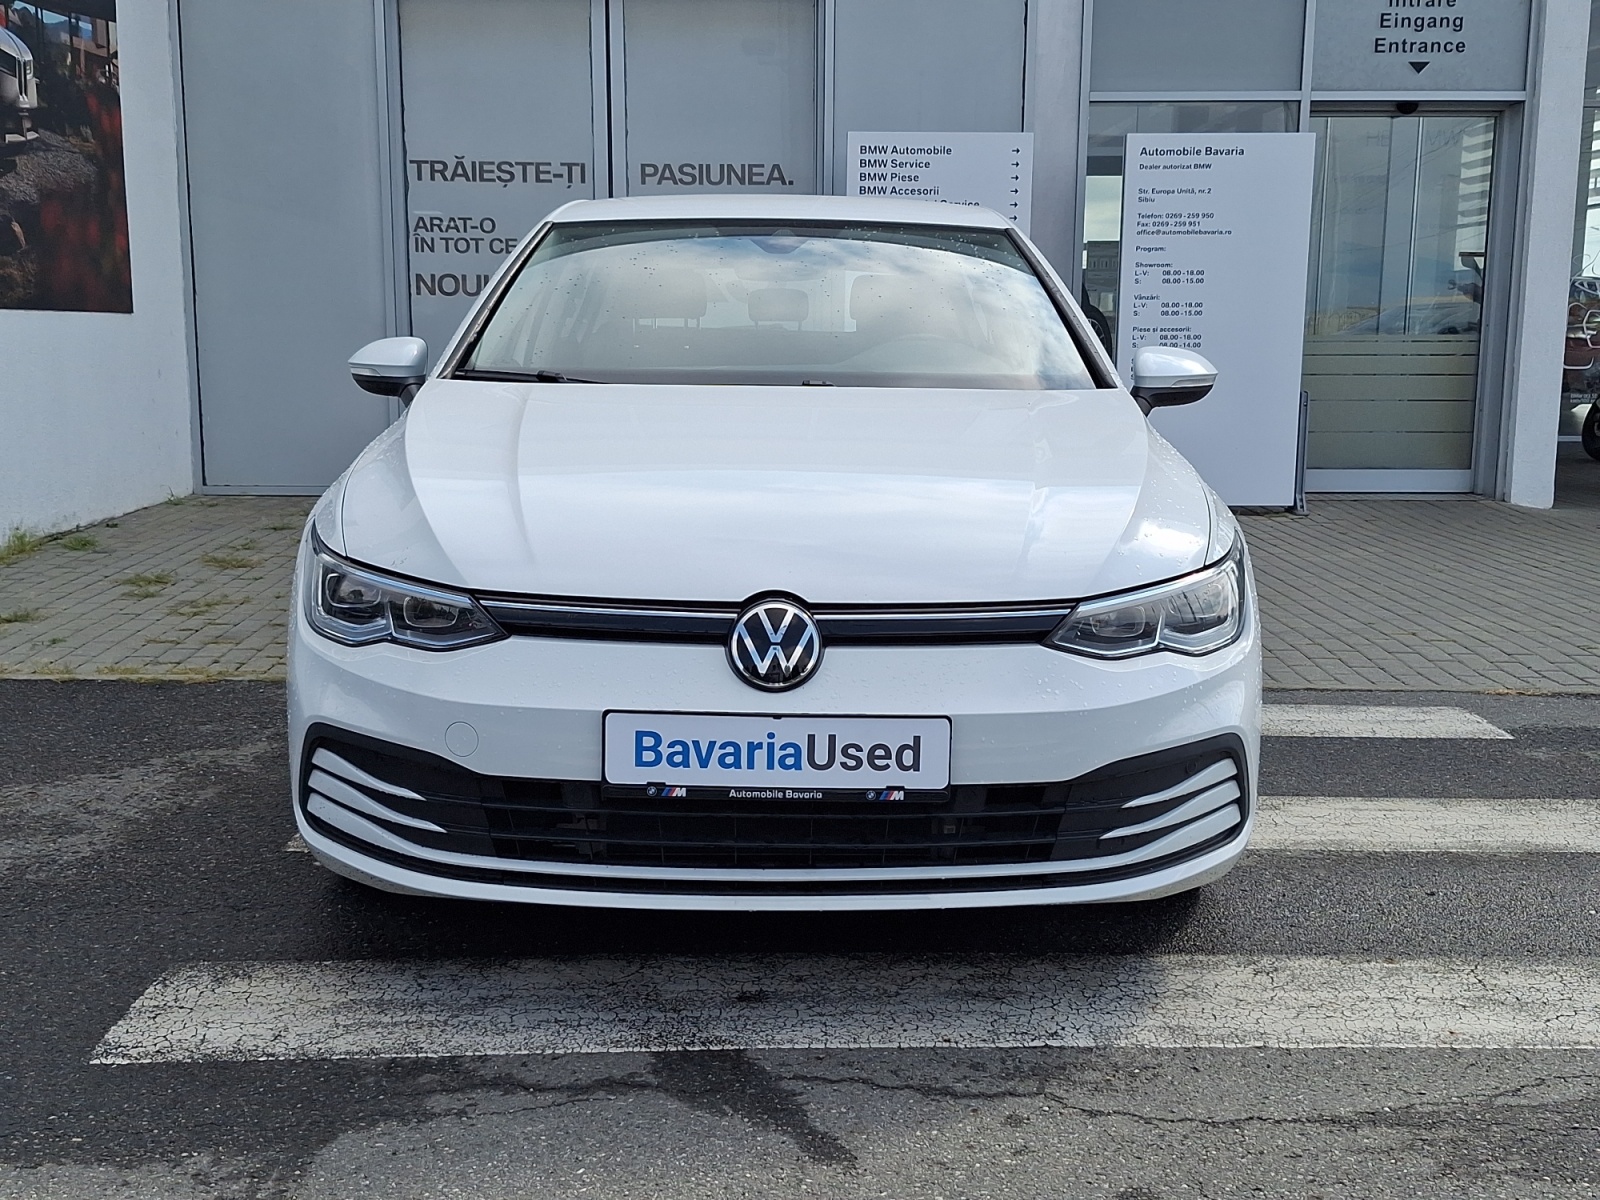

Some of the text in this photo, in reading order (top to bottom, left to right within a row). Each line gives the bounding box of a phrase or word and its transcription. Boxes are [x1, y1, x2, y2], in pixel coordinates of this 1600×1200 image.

[1380, 12, 1464, 32] Eingang
[1374, 38, 1466, 53] Entrance
[859, 145, 952, 155] BMW Automobile
[1140, 146, 1245, 156] Automobile Bavaria
[859, 159, 930, 168] BMW Service
[410, 156, 794, 188] TRĂIEȘTE-ȚI PASIUNEA.
[859, 173, 919, 182] BMW Piese
[859, 186, 939, 195] BMW Accesorii
[413, 216, 496, 234] ARAT-O
[413, 233, 518, 254] ÎN TOT CE
[634, 729, 922, 773] BavariaUsed
[729, 789, 823, 799] Automobile Bavaria
